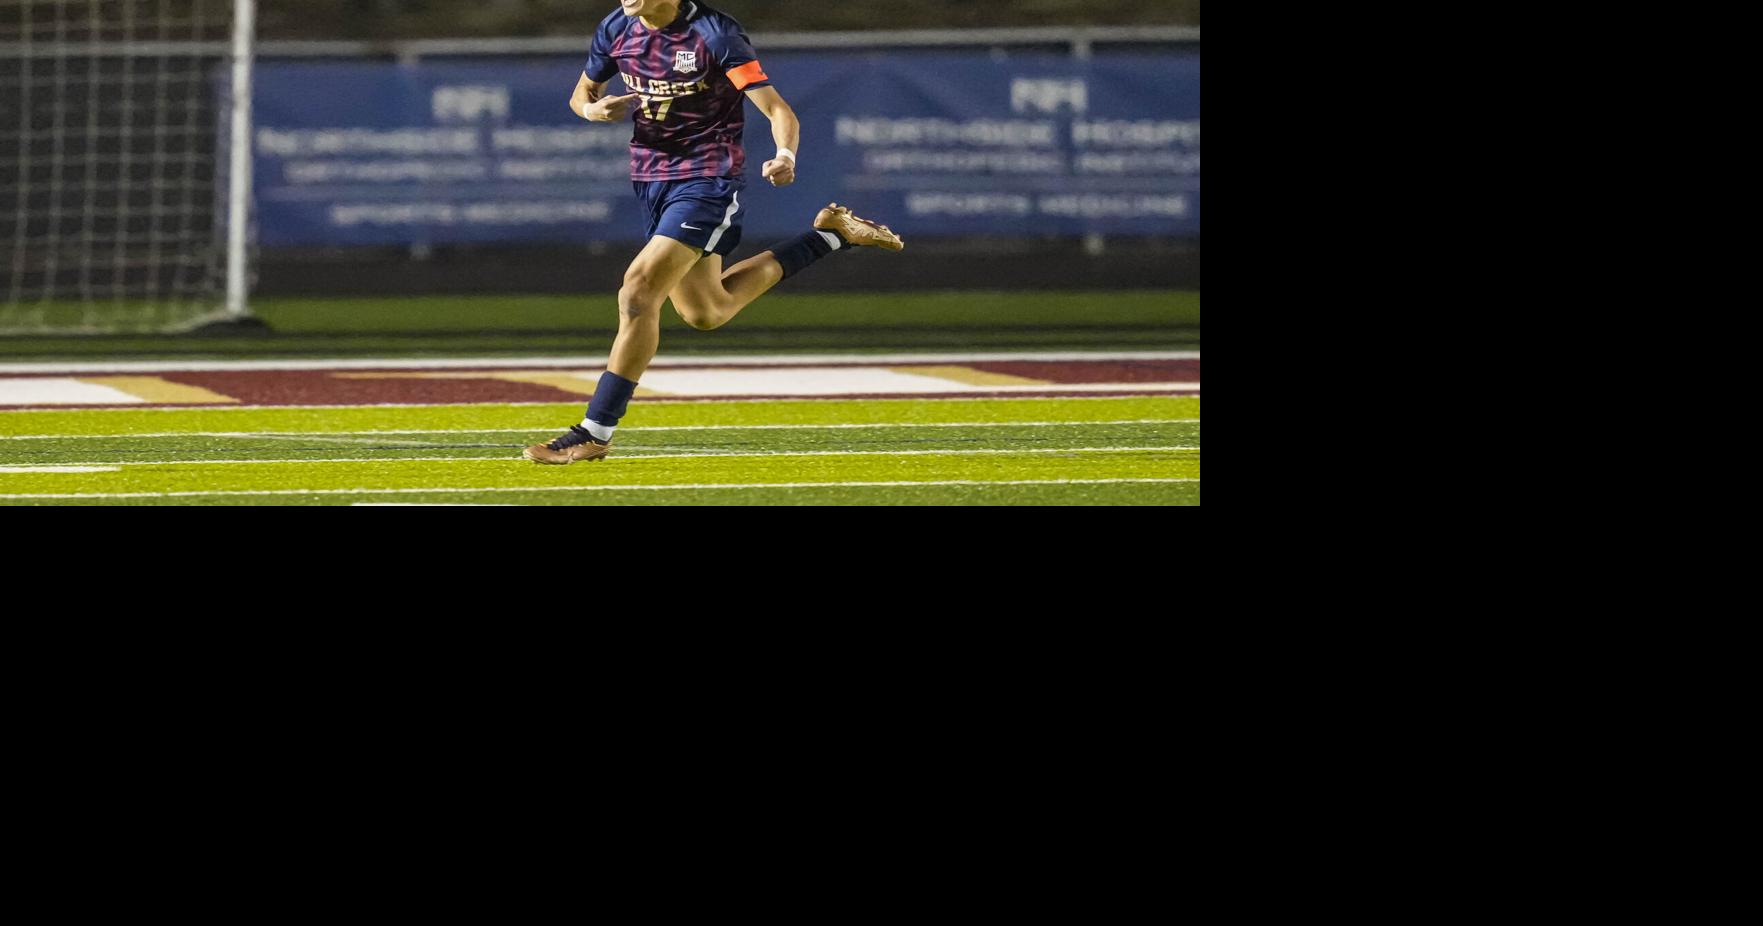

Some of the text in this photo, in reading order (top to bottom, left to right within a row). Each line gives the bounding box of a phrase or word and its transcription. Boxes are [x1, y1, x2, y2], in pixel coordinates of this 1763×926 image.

[677, 52, 694, 61] MC
[648, 79, 710, 95] CREEK
[638, 94, 675, 122] 17
